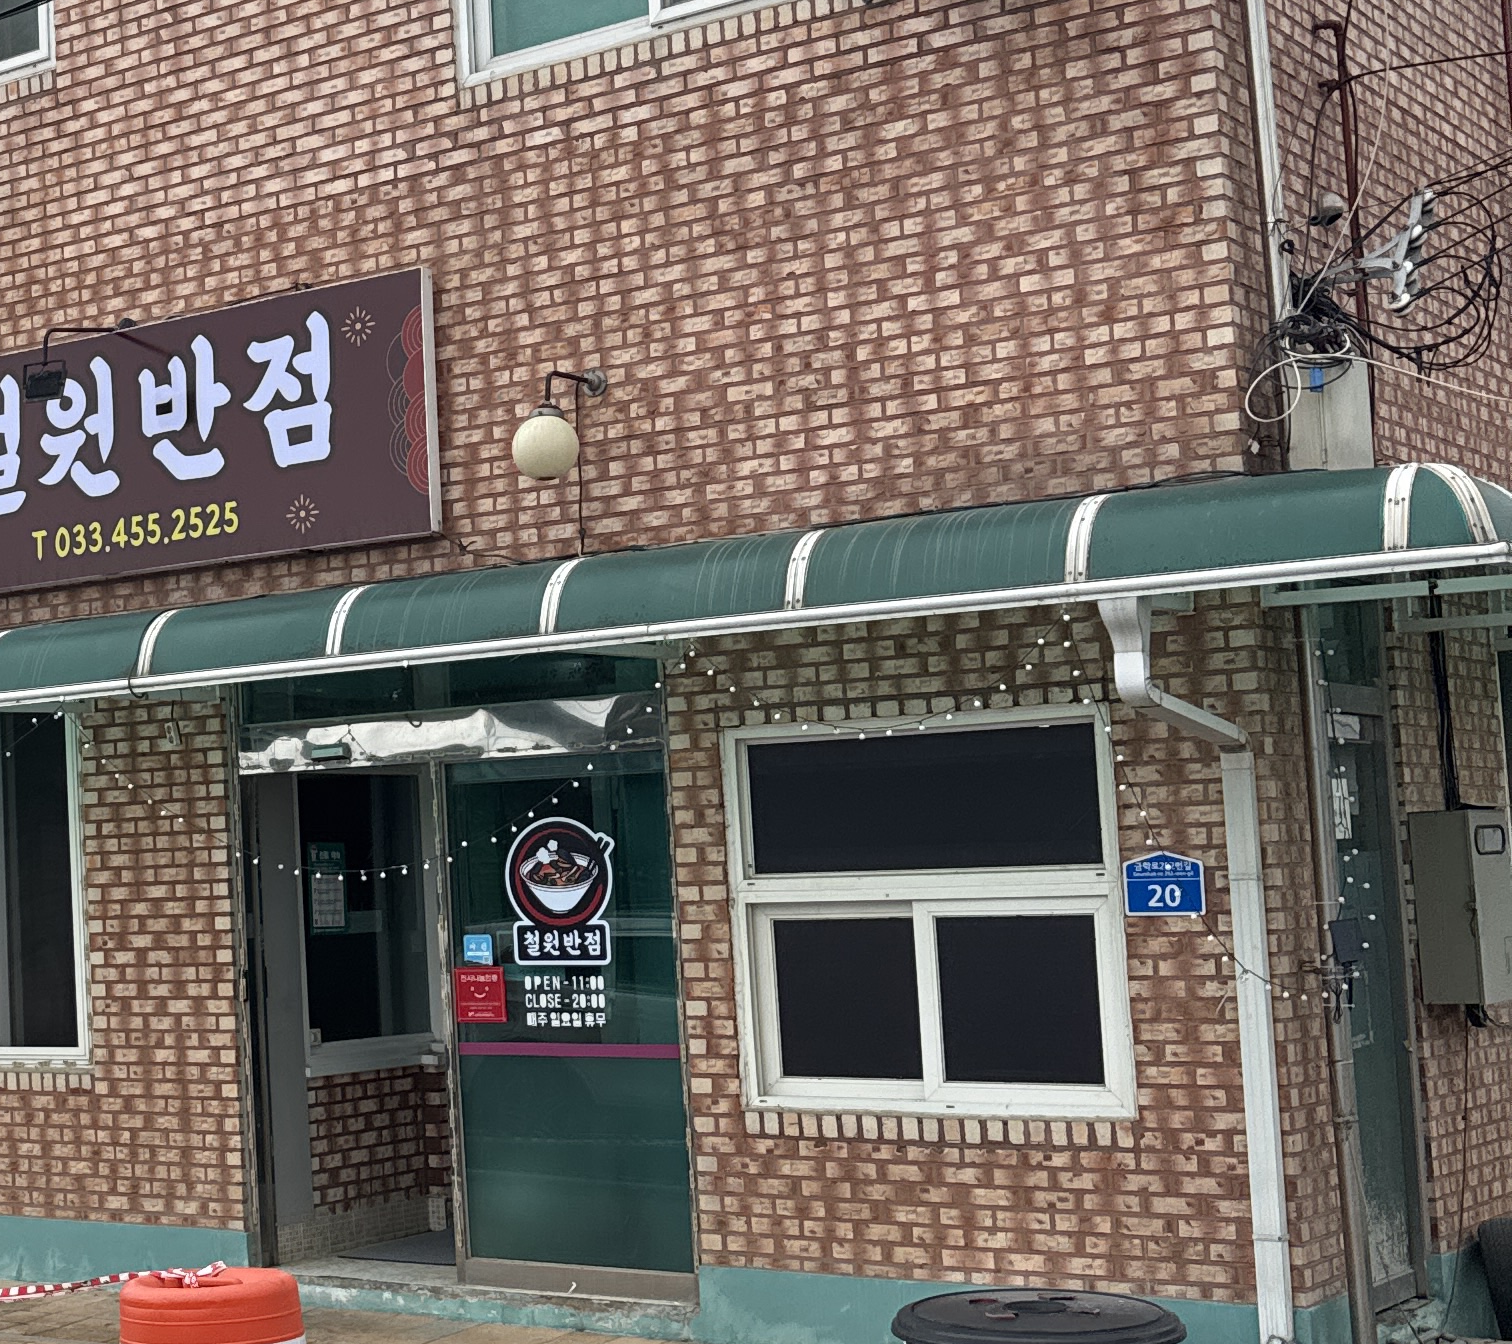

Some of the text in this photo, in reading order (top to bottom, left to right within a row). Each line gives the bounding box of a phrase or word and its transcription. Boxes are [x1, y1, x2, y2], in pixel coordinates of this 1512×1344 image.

[31, 500, 240, 561] T 033.455.2525
[1147, 883, 1182, 907] 20
[523, 928, 602, 956] 철원반점
[524, 975, 561, 991] OPEN
[571, 975, 605, 991] 11:00
[525, 993, 562, 1008] CLOSE
[571, 993, 606, 1008] 20:00
[550, 1012, 583, 1028] 일요일
[584, 1012, 607, 1028] 휴무
